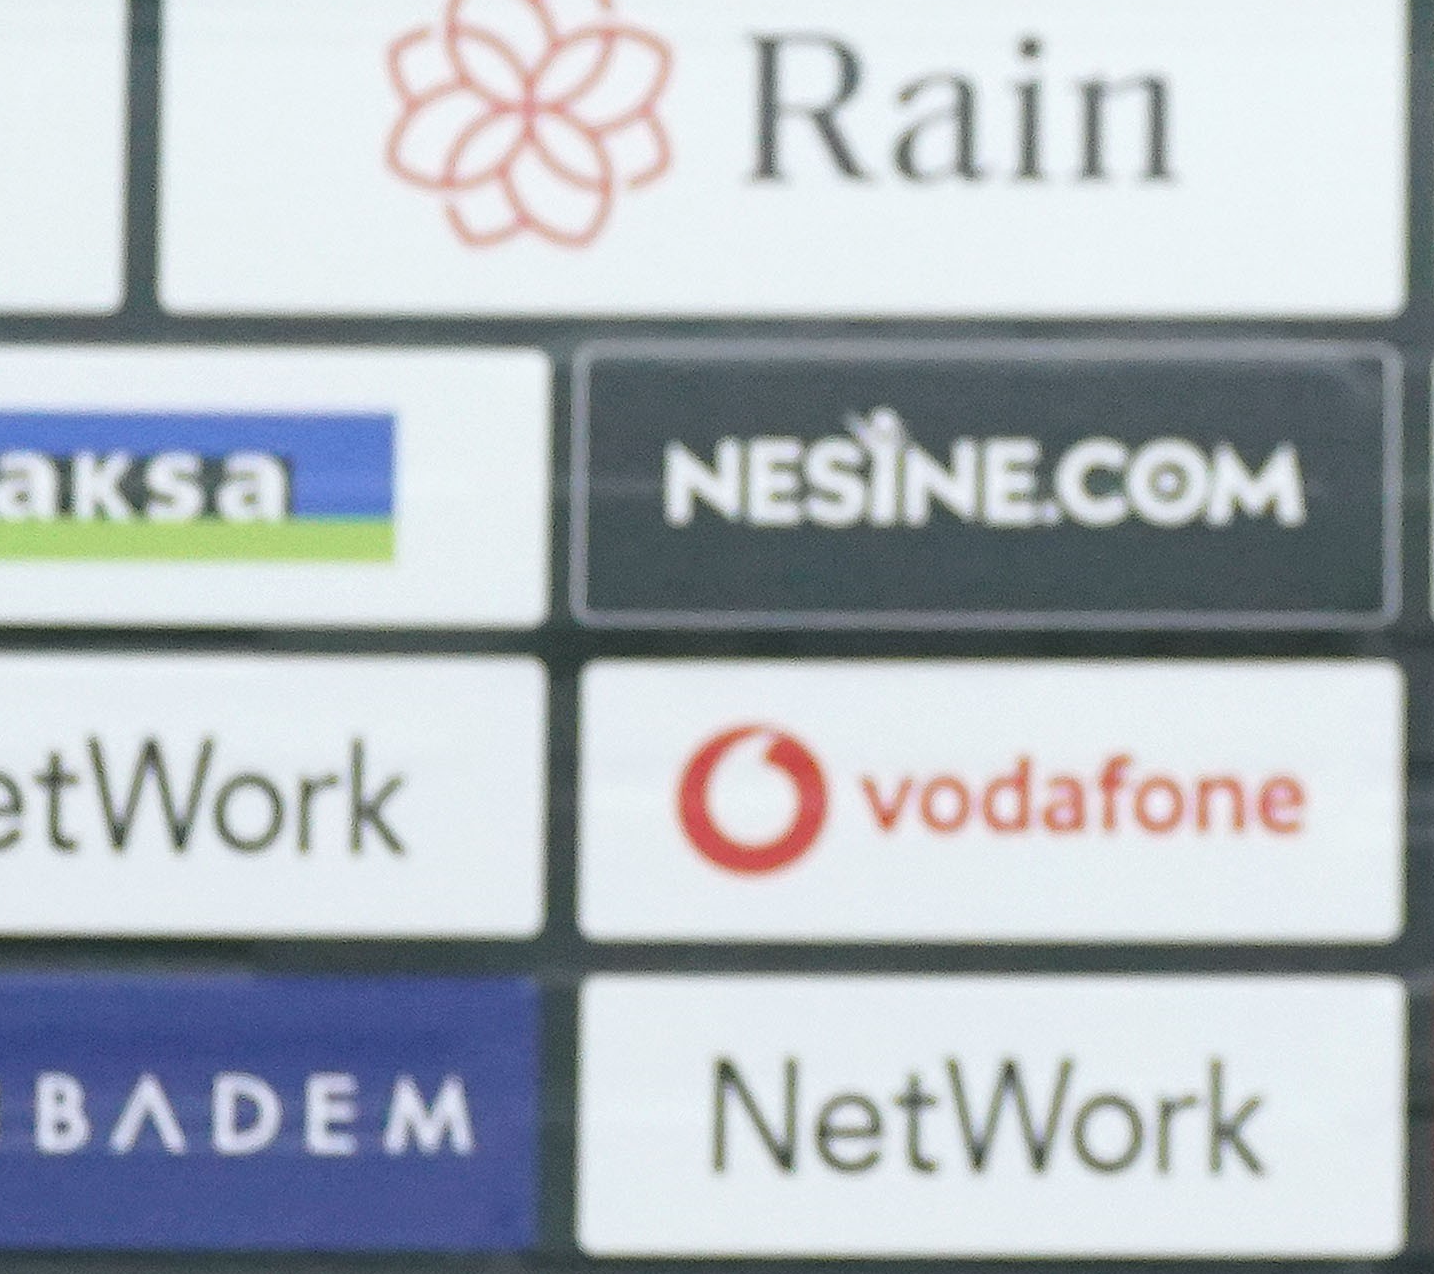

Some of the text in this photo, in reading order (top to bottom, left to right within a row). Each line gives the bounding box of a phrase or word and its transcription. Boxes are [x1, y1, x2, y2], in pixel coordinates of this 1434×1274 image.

[751, 34, 1172, 184] Rain
[859, 752, 1307, 836] vodafone
[711, 1055, 1265, 1177] NetWork
